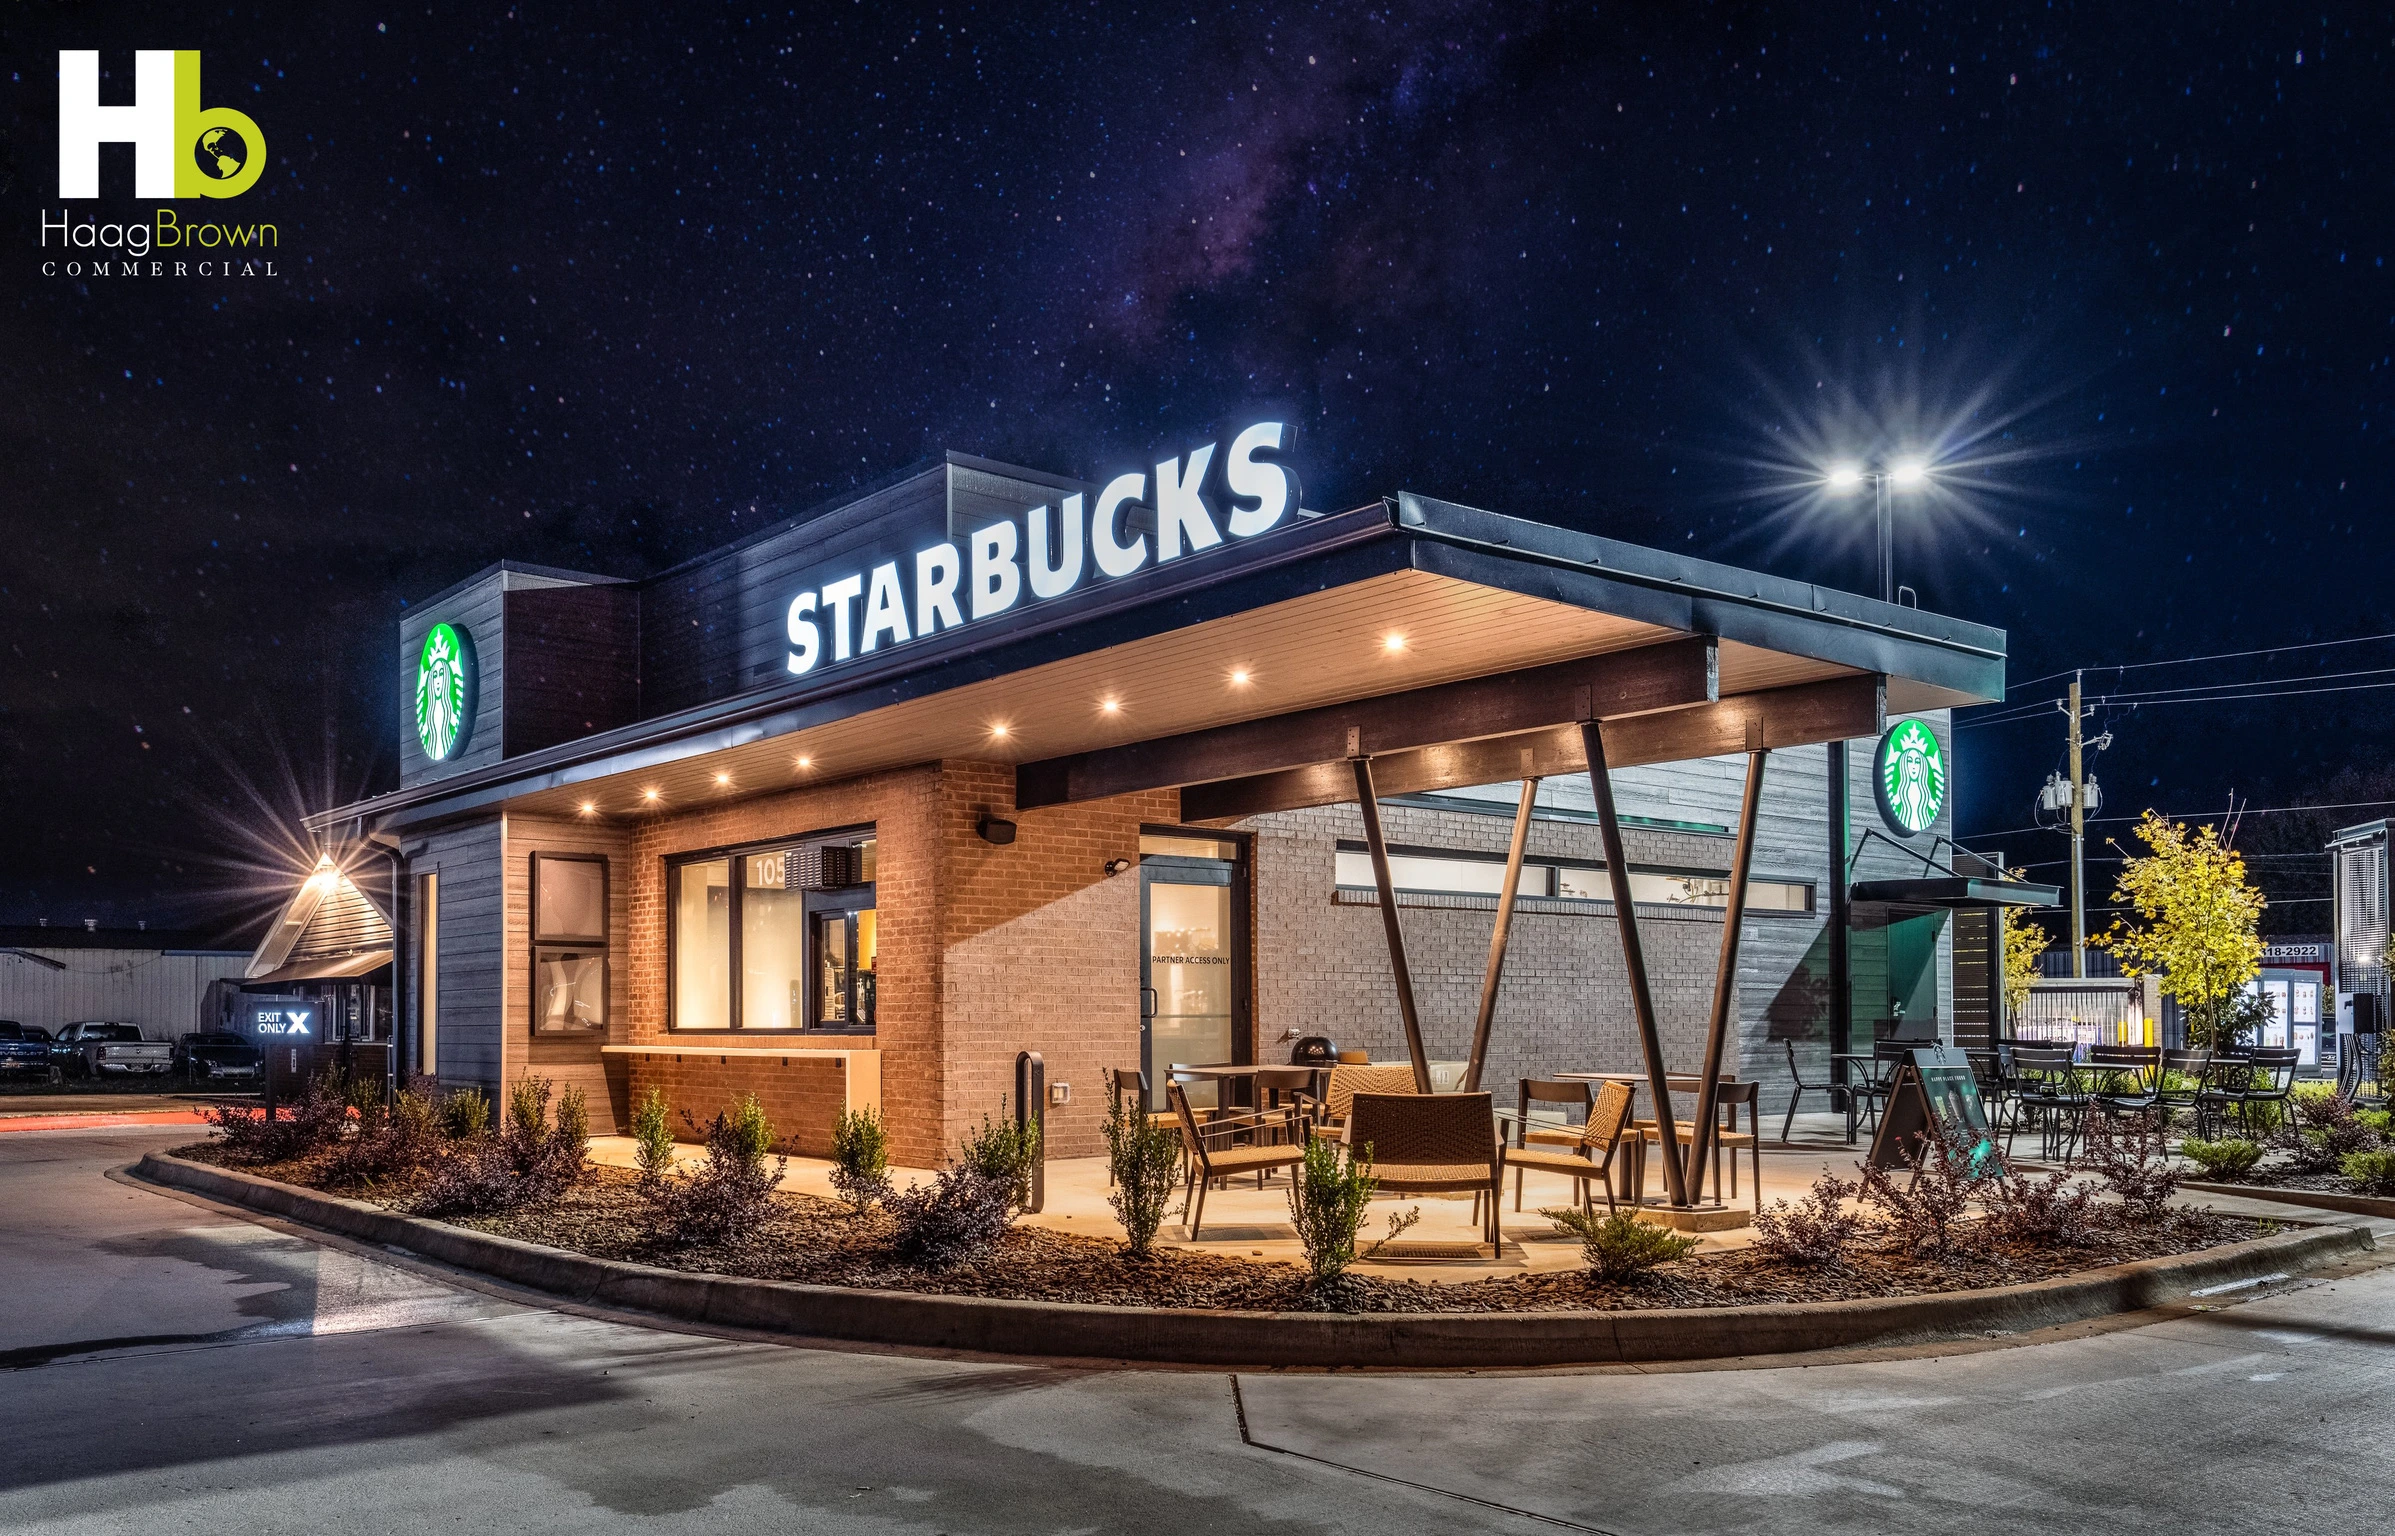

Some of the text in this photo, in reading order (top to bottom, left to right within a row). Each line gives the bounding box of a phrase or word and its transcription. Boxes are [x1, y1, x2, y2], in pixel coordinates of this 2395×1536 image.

[786, 421, 1292, 675] STARBUCKS
[756, 856, 785, 886] 105
[1152, 955, 1230, 965] PARTNER ACCESS ONLY
[258, 1012, 282, 1023] EXIT
[258, 1023, 287, 1034] ONLY
